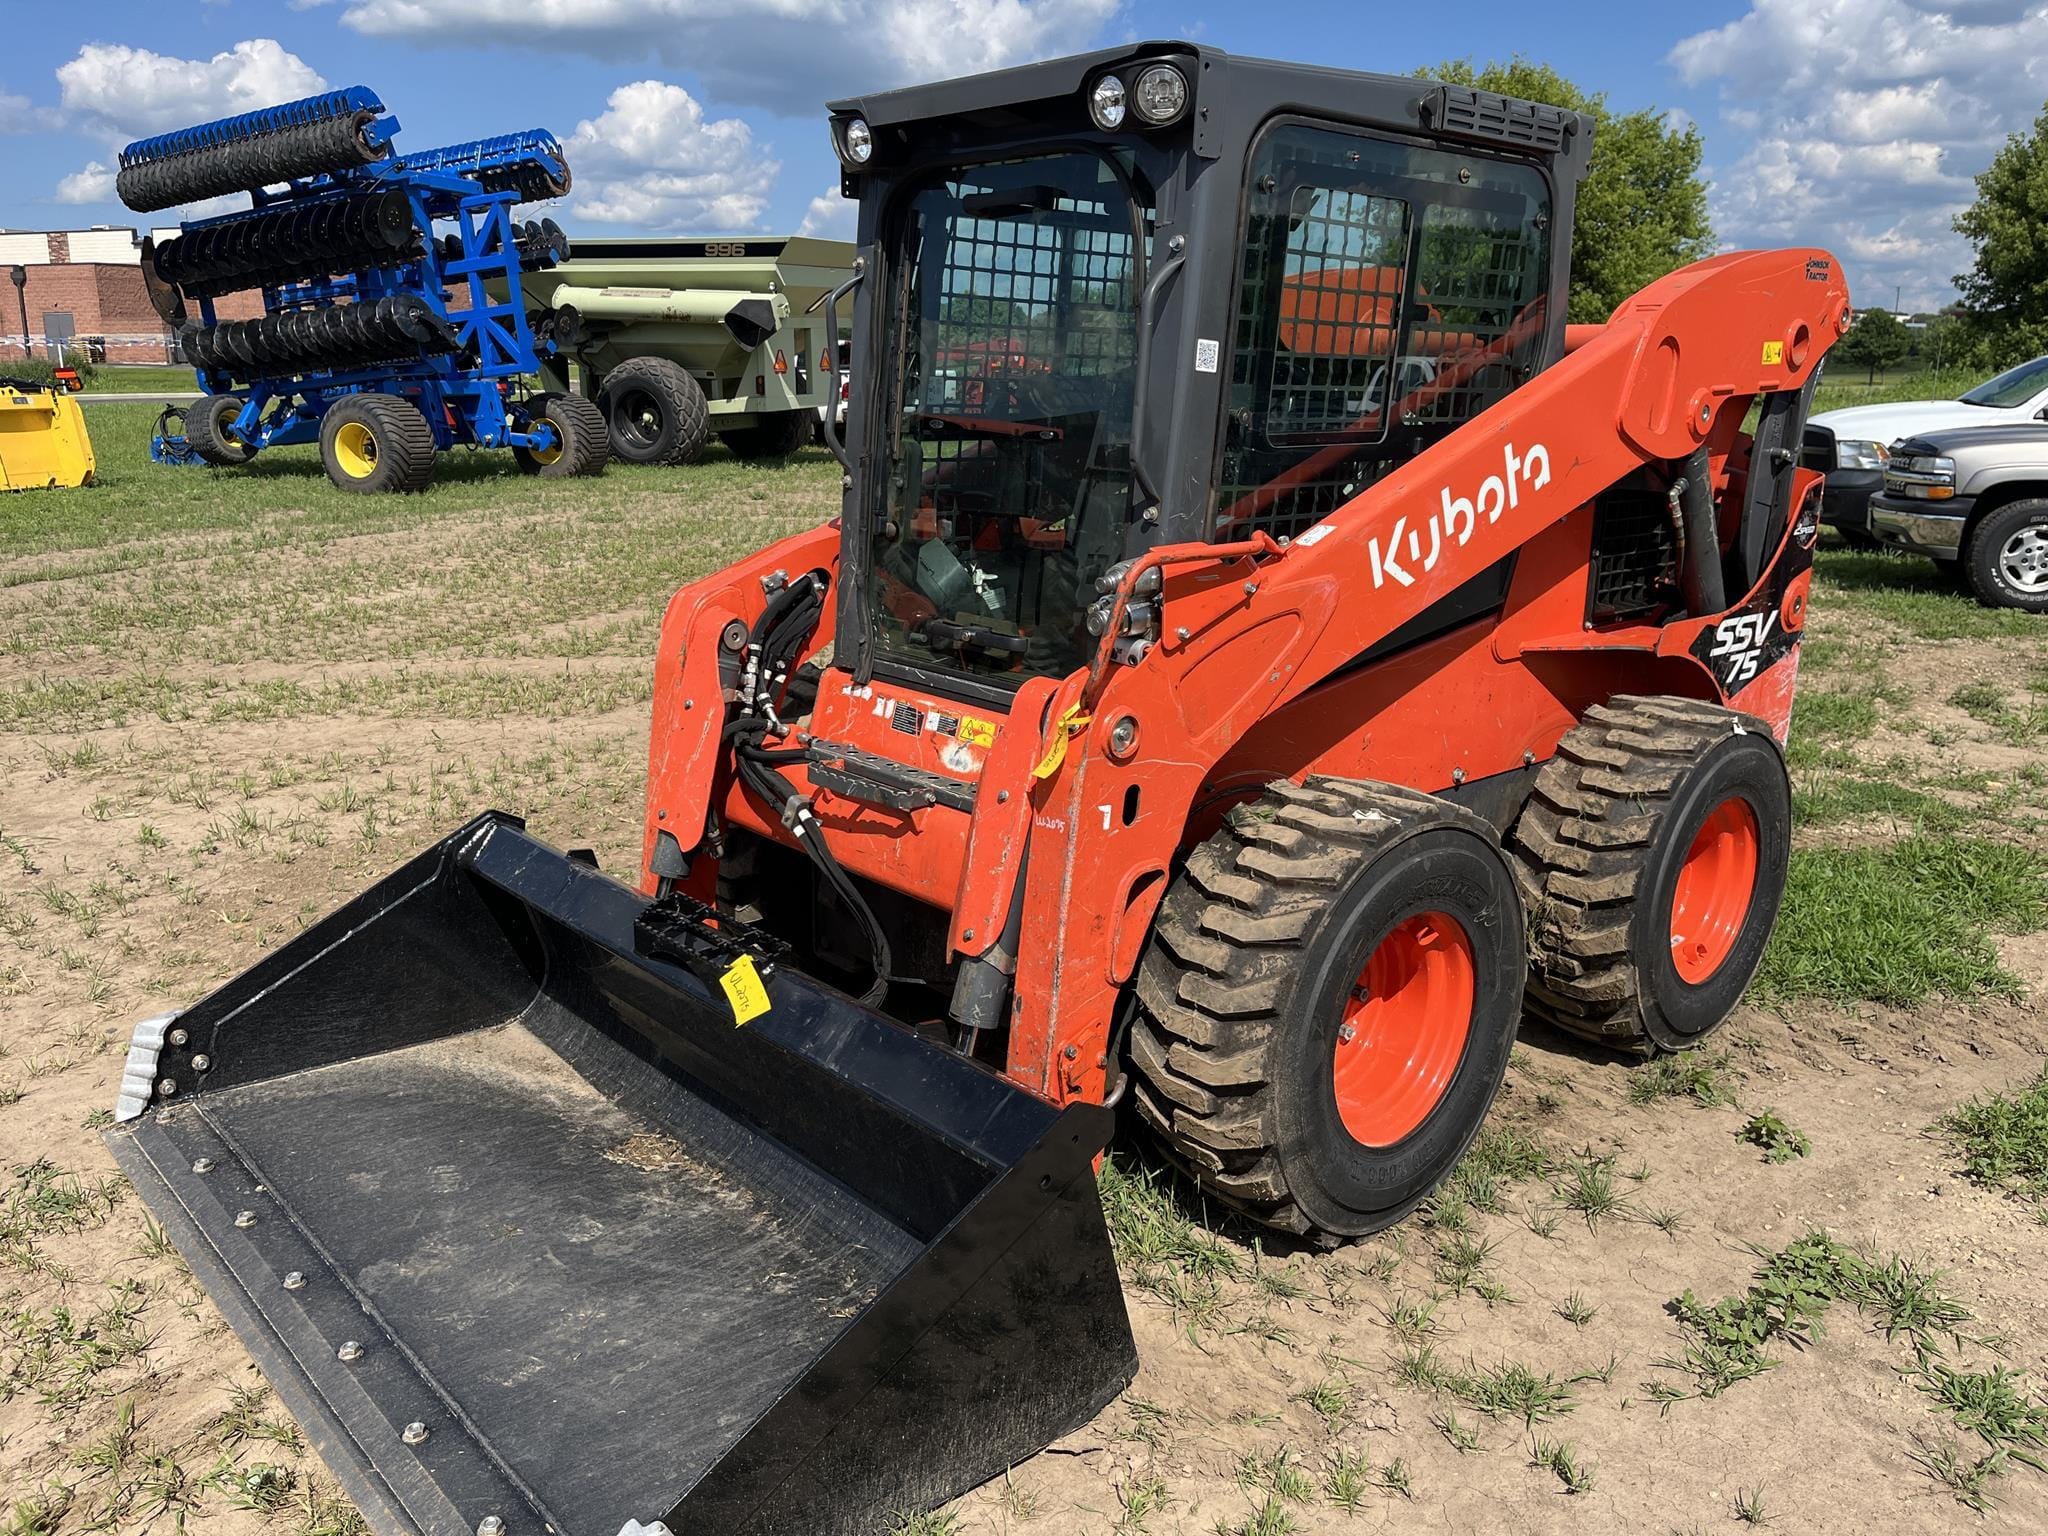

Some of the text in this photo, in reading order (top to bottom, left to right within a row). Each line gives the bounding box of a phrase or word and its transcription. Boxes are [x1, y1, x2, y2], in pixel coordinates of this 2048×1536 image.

[705, 244, 745, 256] 996
[1805, 269, 1828, 281] TRACTOR
[1368, 442, 1551, 589] Kubota
[1709, 609, 1779, 657] SSV
[1726, 649, 1761, 684] 75
